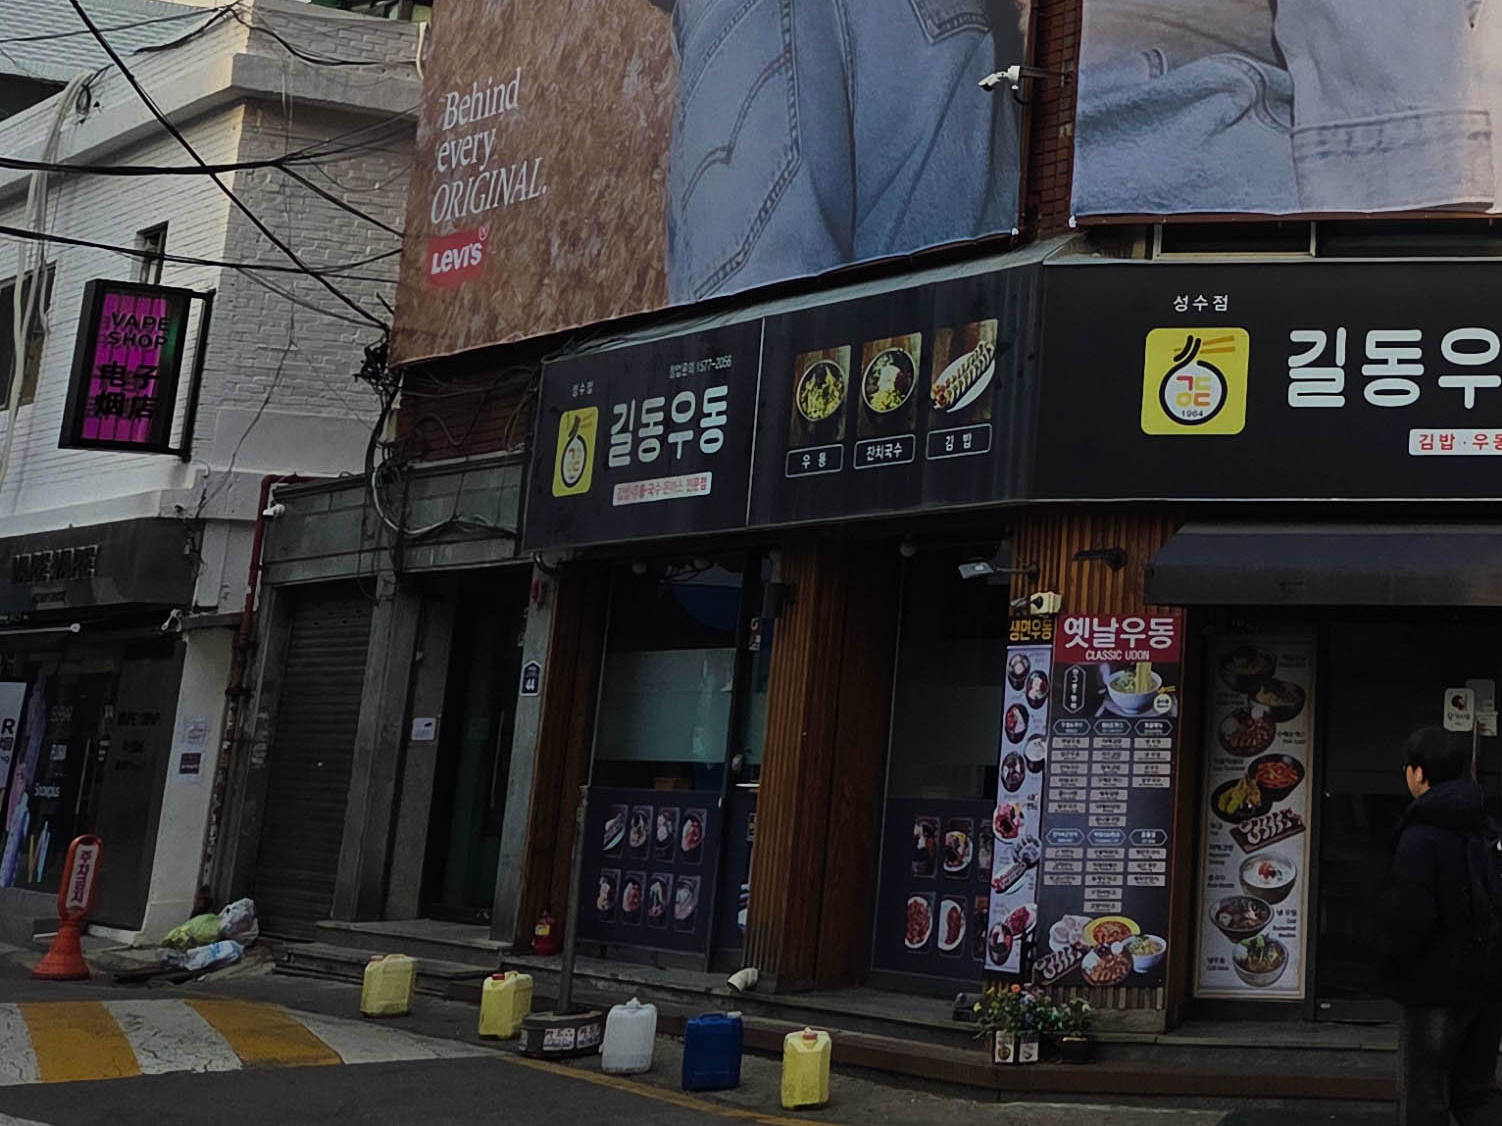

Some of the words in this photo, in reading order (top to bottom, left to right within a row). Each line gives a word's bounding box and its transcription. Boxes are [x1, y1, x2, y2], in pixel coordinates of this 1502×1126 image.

[442, 66, 521, 131] Behind
[437, 128, 496, 173] every
[431, 157, 547, 224] ORIGINAL.
[1172, 294, 1229, 312] 성수점
[111, 312, 172, 332] VAPE
[106, 330, 169, 350] SHOP
[96, 360, 160, 390] 电子
[608, 385, 729, 468] 길동우동
[866, 442, 903, 462] 잔치국수
[944, 432, 973, 452] 김밥
[1418, 434, 1456, 451] 김밥
[801, 452, 828, 470] 우동
[1063, 617, 1175, 650] 옛날우동
[1085, 650, 1123, 661] CLASSIC
[1124, 650, 1150, 661] UDON
